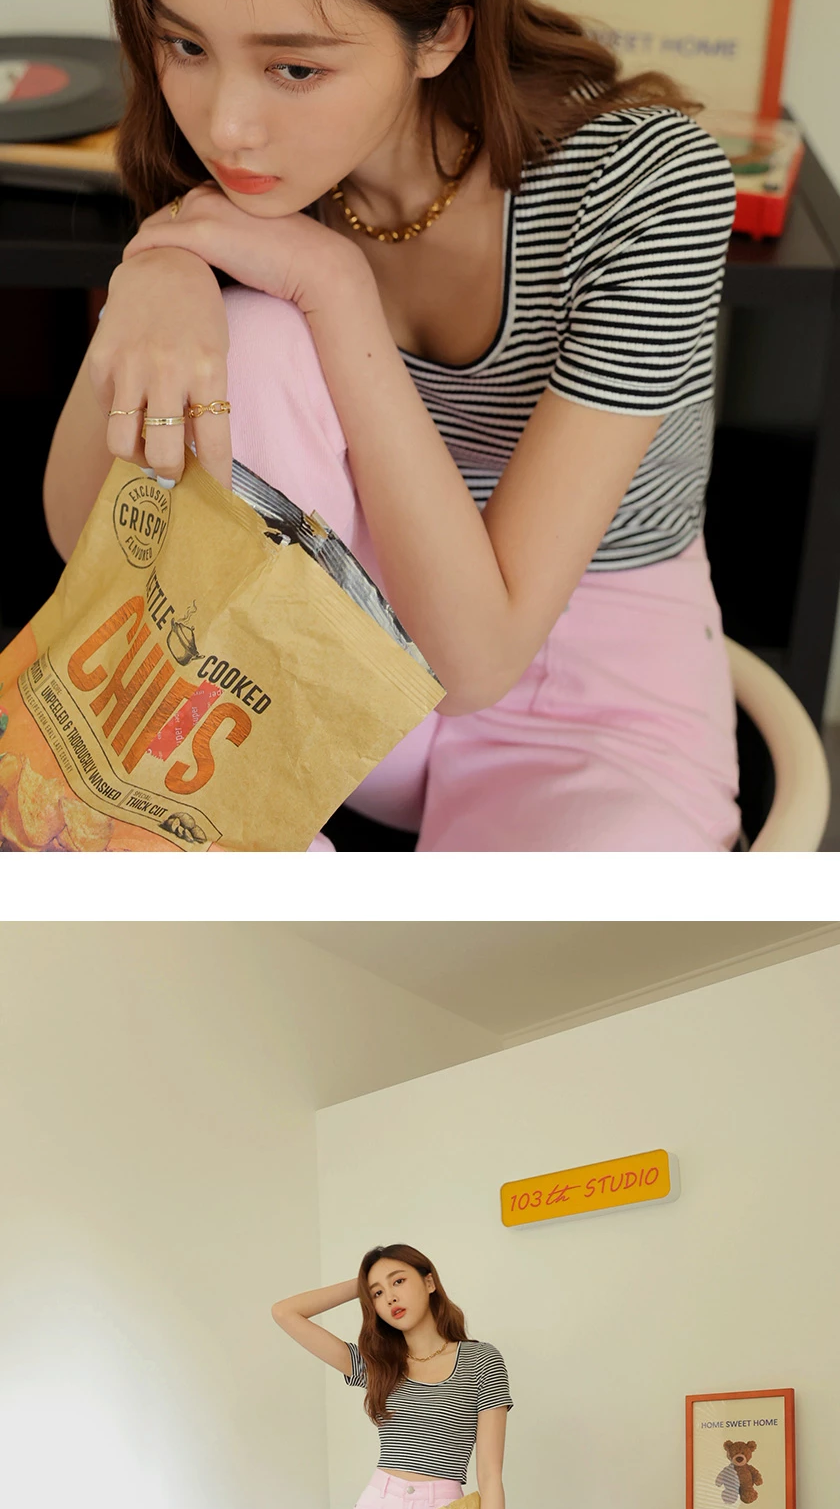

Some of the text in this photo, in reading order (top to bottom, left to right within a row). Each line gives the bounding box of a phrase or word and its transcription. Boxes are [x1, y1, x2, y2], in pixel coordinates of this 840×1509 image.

[128, 484, 170, 514] EXCLUSIVE
[119, 503, 168, 544] CRISPY
[125, 535, 153, 562] FLAVORED
[197, 655, 272, 715] COOKED
[41, 685, 122, 801] UNPEELED & THOROUGHLY WASHED
[126, 796, 168, 818] THICK CUT
[510, 1167, 659, 1212] 103th STUDIO
[701, 1418, 778, 1429] HOME SWEET HOME
